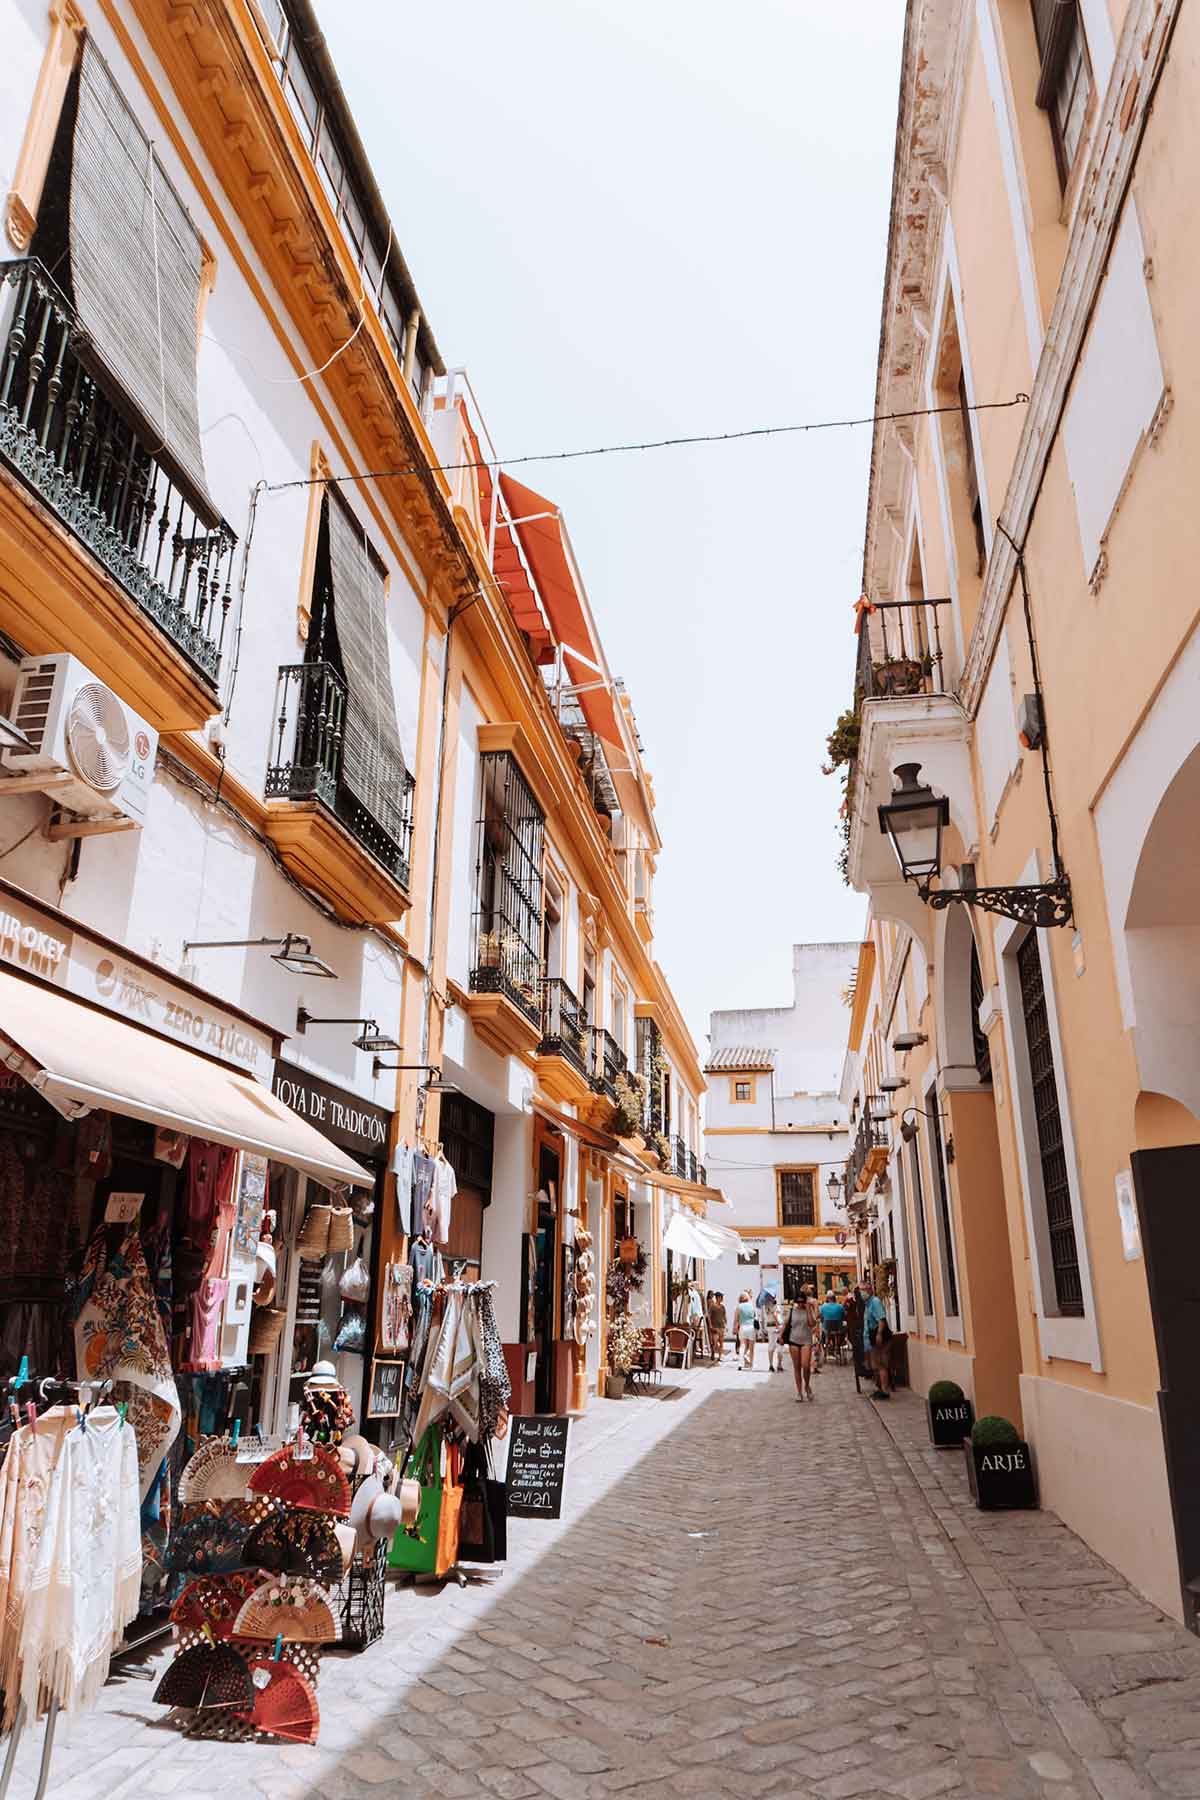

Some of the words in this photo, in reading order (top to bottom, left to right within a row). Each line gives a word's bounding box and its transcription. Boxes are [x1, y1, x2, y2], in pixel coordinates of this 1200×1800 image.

[131, 759, 145, 780] LG
[163, 1000, 204, 1039] ZERO
[310, 1091, 327, 1121] DE
[330, 1099, 387, 1144] TRADICIÓN
[935, 1404, 969, 1421] ARJÉ
[980, 1448, 1026, 1473] ARJÉ
[508, 1491, 551, 1506] evian
